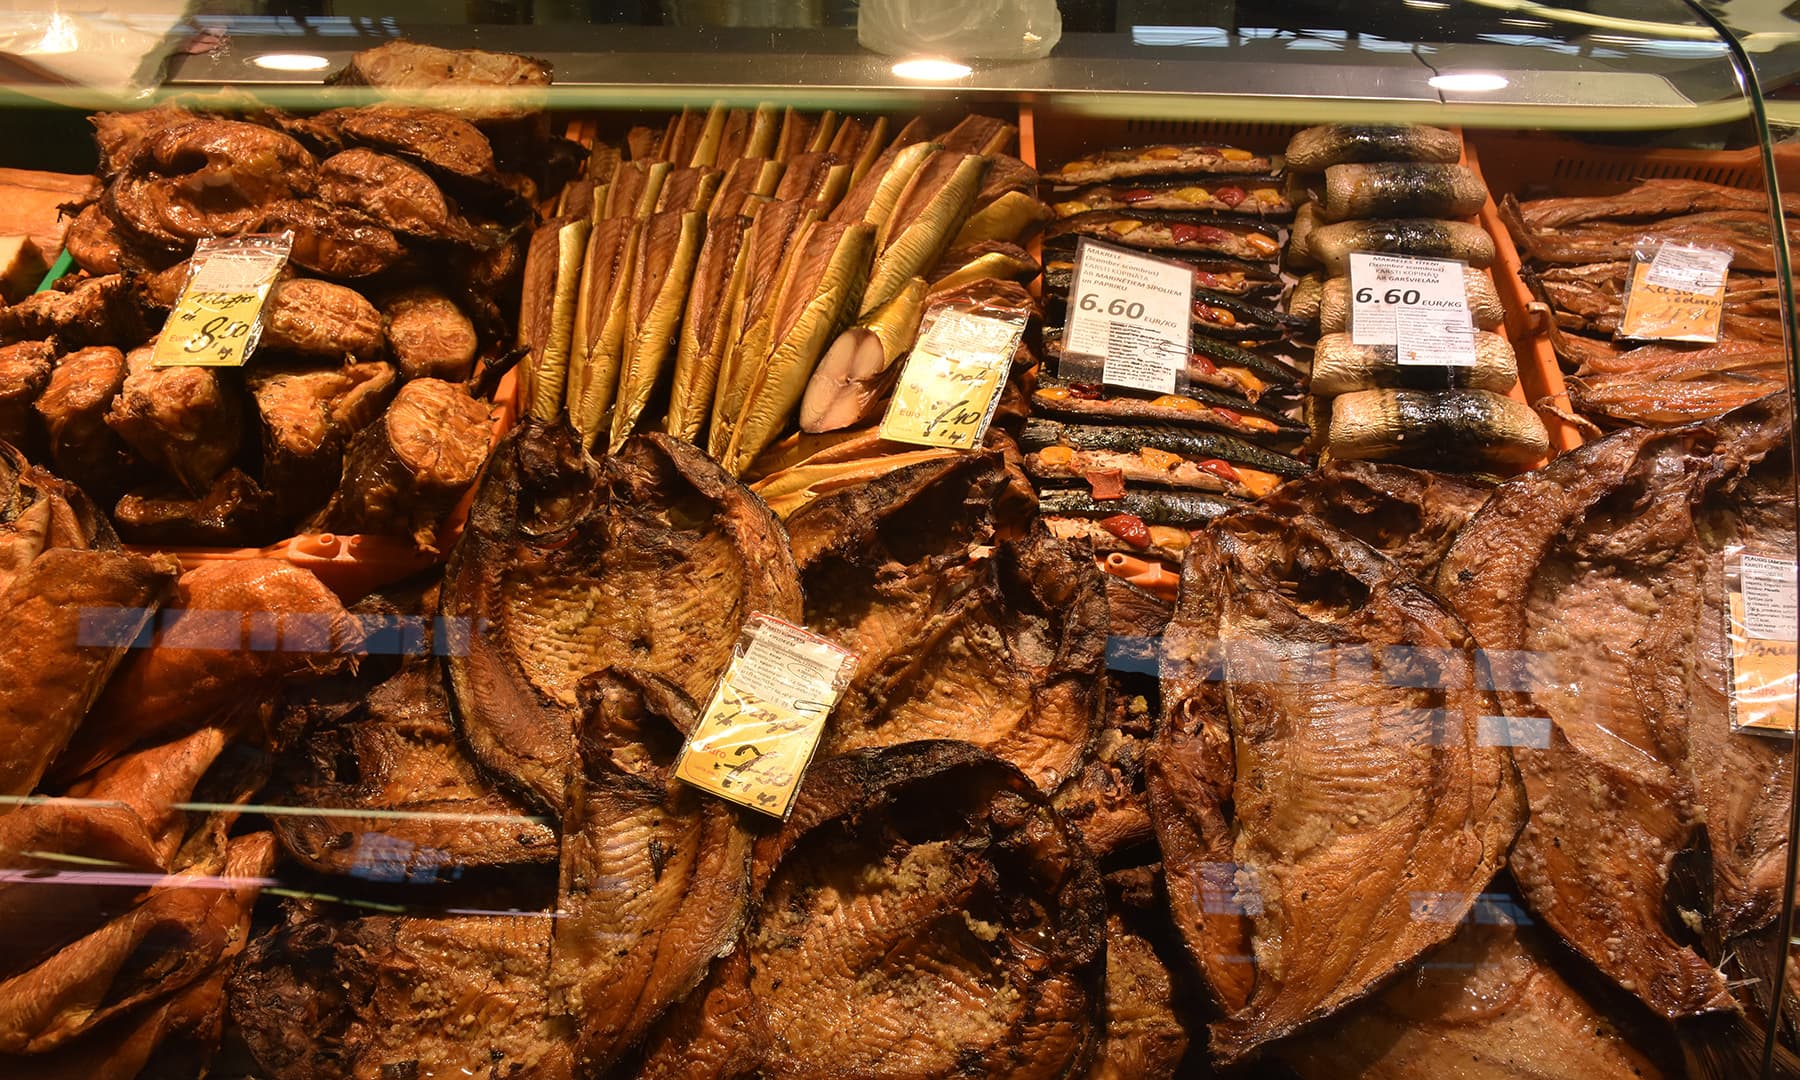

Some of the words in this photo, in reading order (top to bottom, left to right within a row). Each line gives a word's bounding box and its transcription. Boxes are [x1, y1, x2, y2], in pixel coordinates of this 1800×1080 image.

[1093, 280, 1128, 292] PAPRIKU
[1356, 287, 1421, 306] 6.60
[1422, 299, 1463, 308] EUR/KG
[1080, 293, 1144, 319] 6.60
[1144, 315, 1177, 328] EUR/KG
